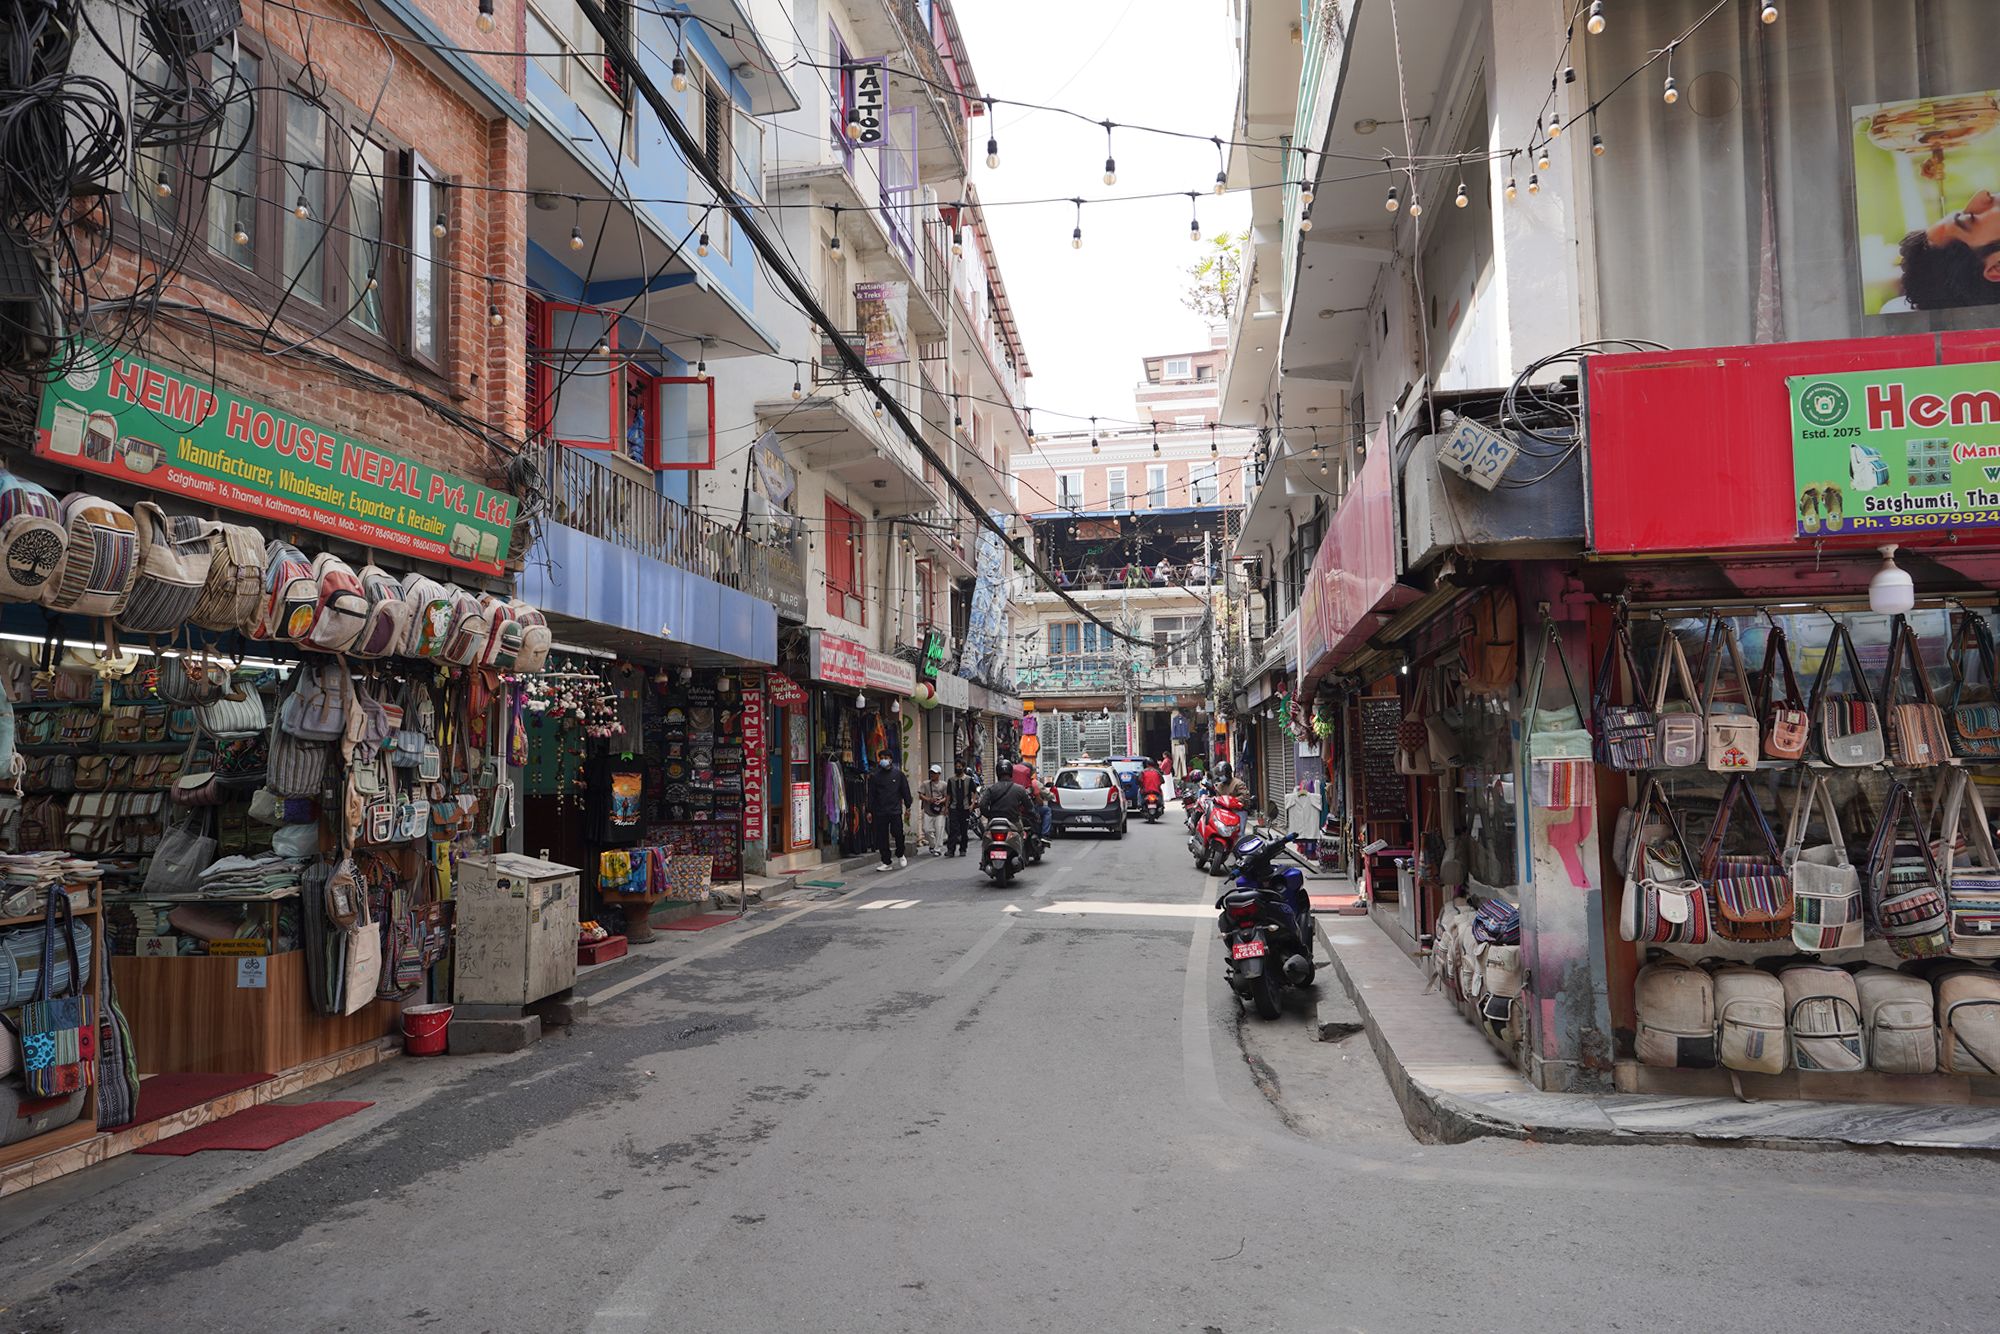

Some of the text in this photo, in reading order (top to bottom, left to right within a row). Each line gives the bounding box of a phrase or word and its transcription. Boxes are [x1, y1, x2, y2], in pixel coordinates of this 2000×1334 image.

[858, 63, 882, 142] TATTOO
[863, 291, 881, 299] Treks
[1865, 383, 2000, 431] Hem
[108, 357, 218, 428] HEMP
[226, 400, 335, 470] HOUSE
[341, 442, 422, 500] NEPAL
[428, 474, 468, 514] Pvt.
[474, 490, 511, 528] Ltd.
[1802, 427, 1861, 440] Estd. 2075
[1952, 443, 2000, 463] (Man
[177, 436, 447, 536] Manufacturer, Wholesaler, Exporter & Retailer
[167, 468, 217, 493] Satghumti-
[218, 484, 230, 498] 16,
[232, 487, 263, 508] Thamel,
[265, 496, 312, 520] Kathmandu,
[313, 510, 337, 529] Nepal,
[360, 524, 374, 536] +977
[1865, 492, 1959, 512] Satghumti,
[1853, 511, 2000, 529] Ph. 986079924
[781, 592, 798, 607] MARG
[768, 677, 787, 686] Funky
[771, 684, 797, 693] Buddha
[742, 692, 761, 838] MONEY CHANGER
